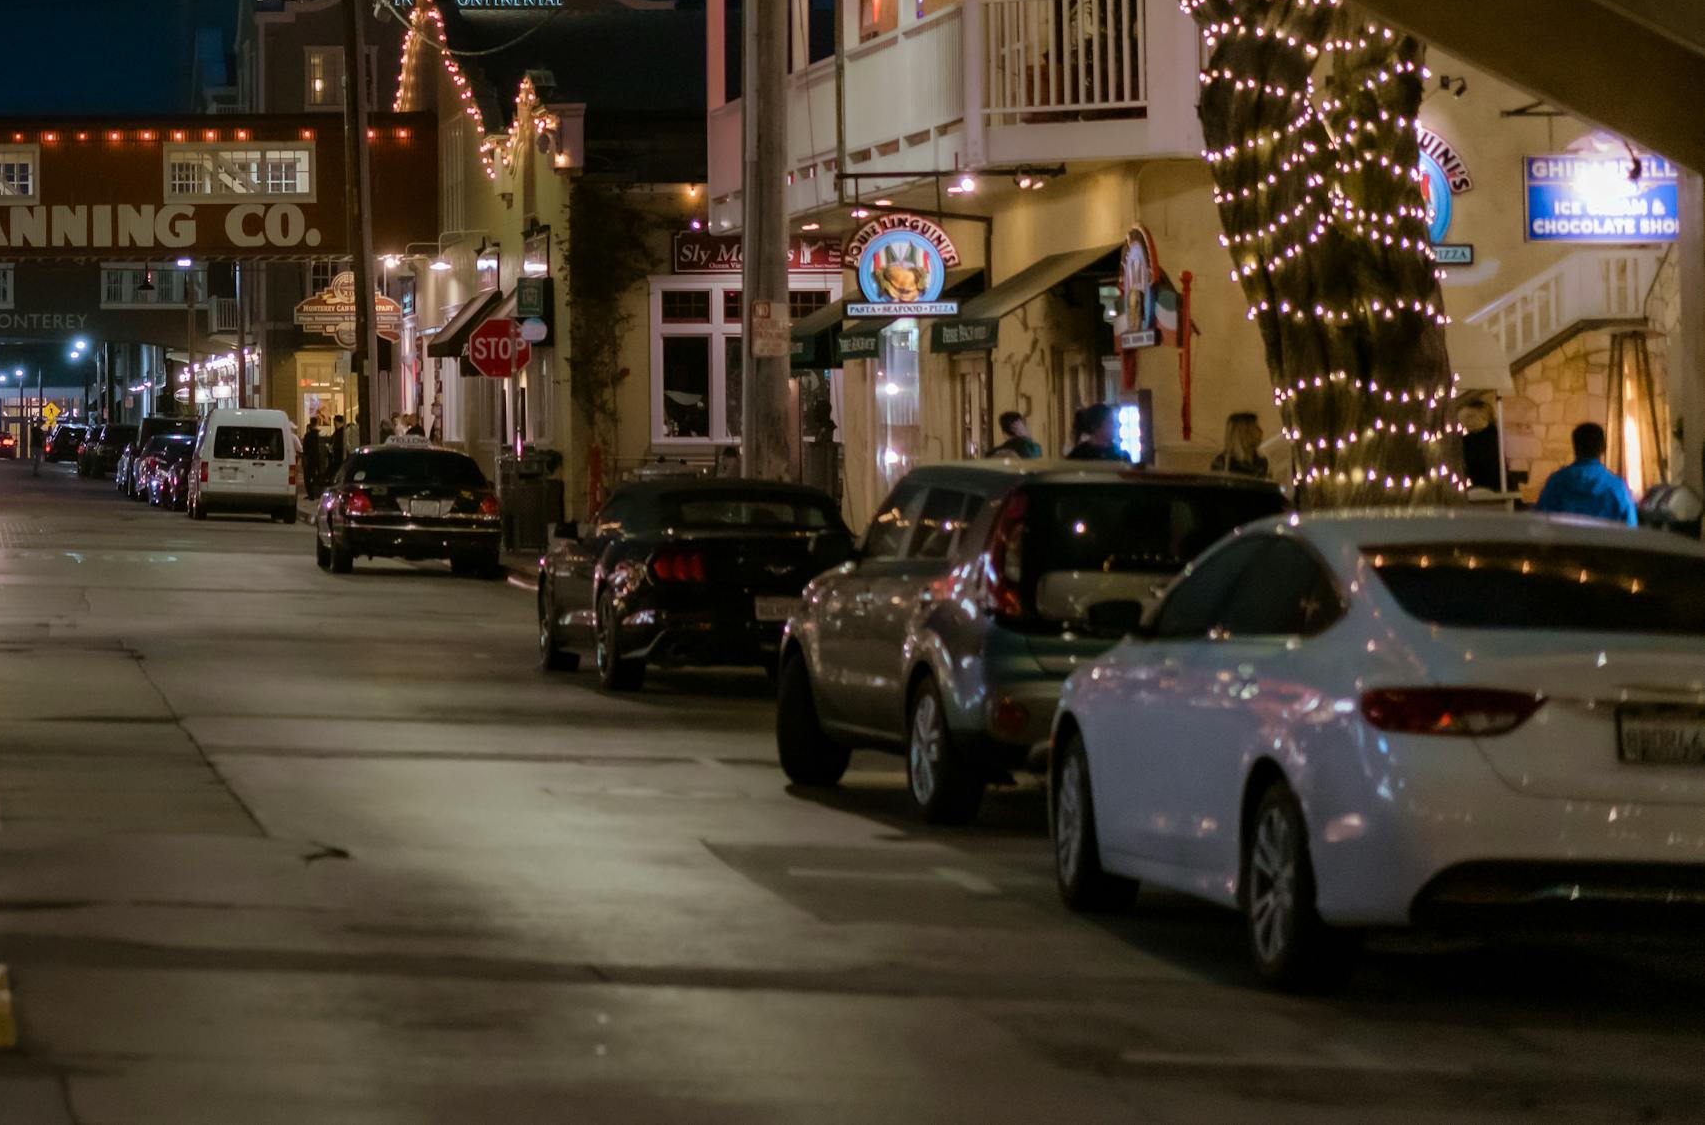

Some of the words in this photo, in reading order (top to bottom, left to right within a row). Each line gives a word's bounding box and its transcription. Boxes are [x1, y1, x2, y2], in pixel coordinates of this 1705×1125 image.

[1554, 200, 1581, 215] ICE
[1652, 199, 1666, 216] &
[224, 203, 323, 248] CO.
[1532, 219, 1636, 235] CHOCOLATE
[680, 243, 711, 265] Sly
[849, 305, 876, 314] PASTA
[882, 305, 923, 313] SEAFOOD
[929, 304, 955, 313] PIZZA
[474, 337, 527, 360] STOP
